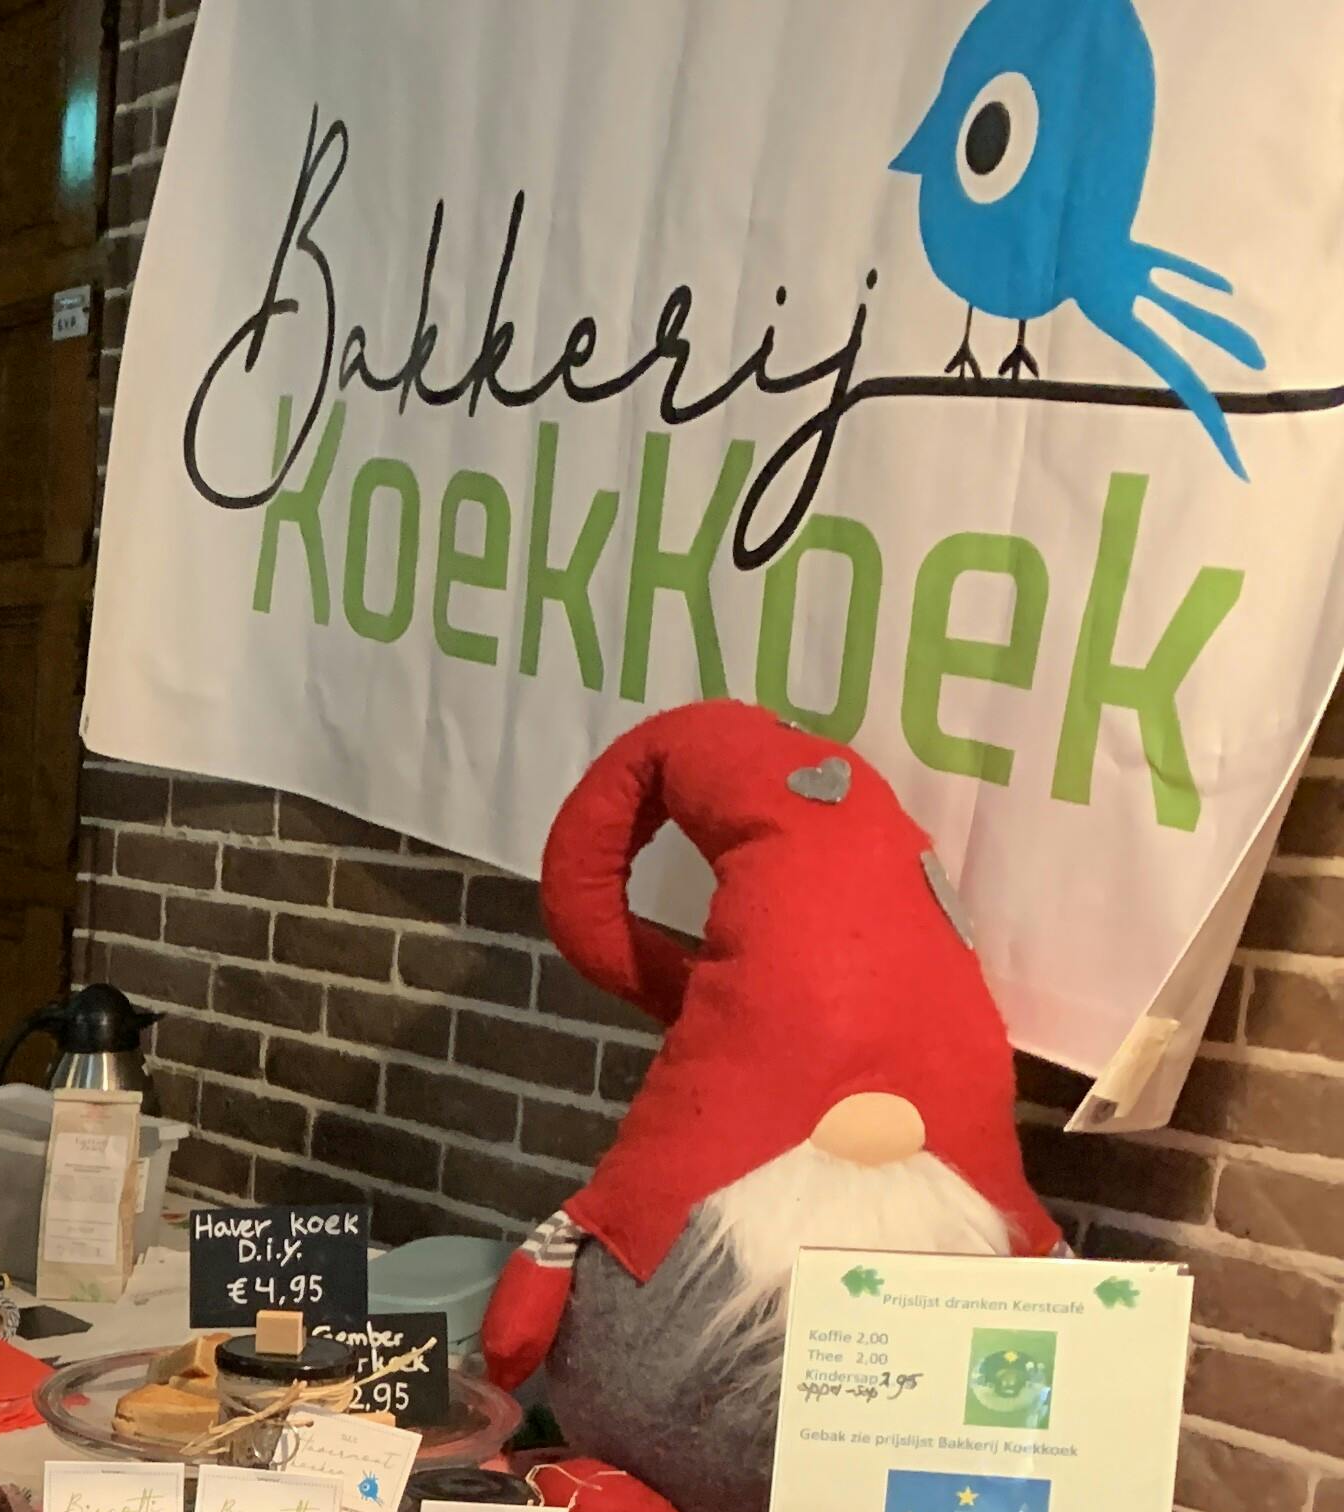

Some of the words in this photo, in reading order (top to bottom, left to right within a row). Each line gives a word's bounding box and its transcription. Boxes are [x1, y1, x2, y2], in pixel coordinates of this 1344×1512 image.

[184, 102, 884, 571] Bakkerij
[195, 1212, 272, 1240] Haver
[882, 1293, 940, 1309] Prijslijst
[945, 1297, 1008, 1312] dranken
[809, 1329, 852, 1345] Koffie
[856, 1331, 889, 1347] 2,00
[807, 1349, 843, 1364] Thee
[856, 1352, 889, 1367] 2,00
[800, 1427, 845, 1443] Gebak
[850, 1431, 871, 1445] zie
[938, 1435, 999, 1454] Bakkerij
